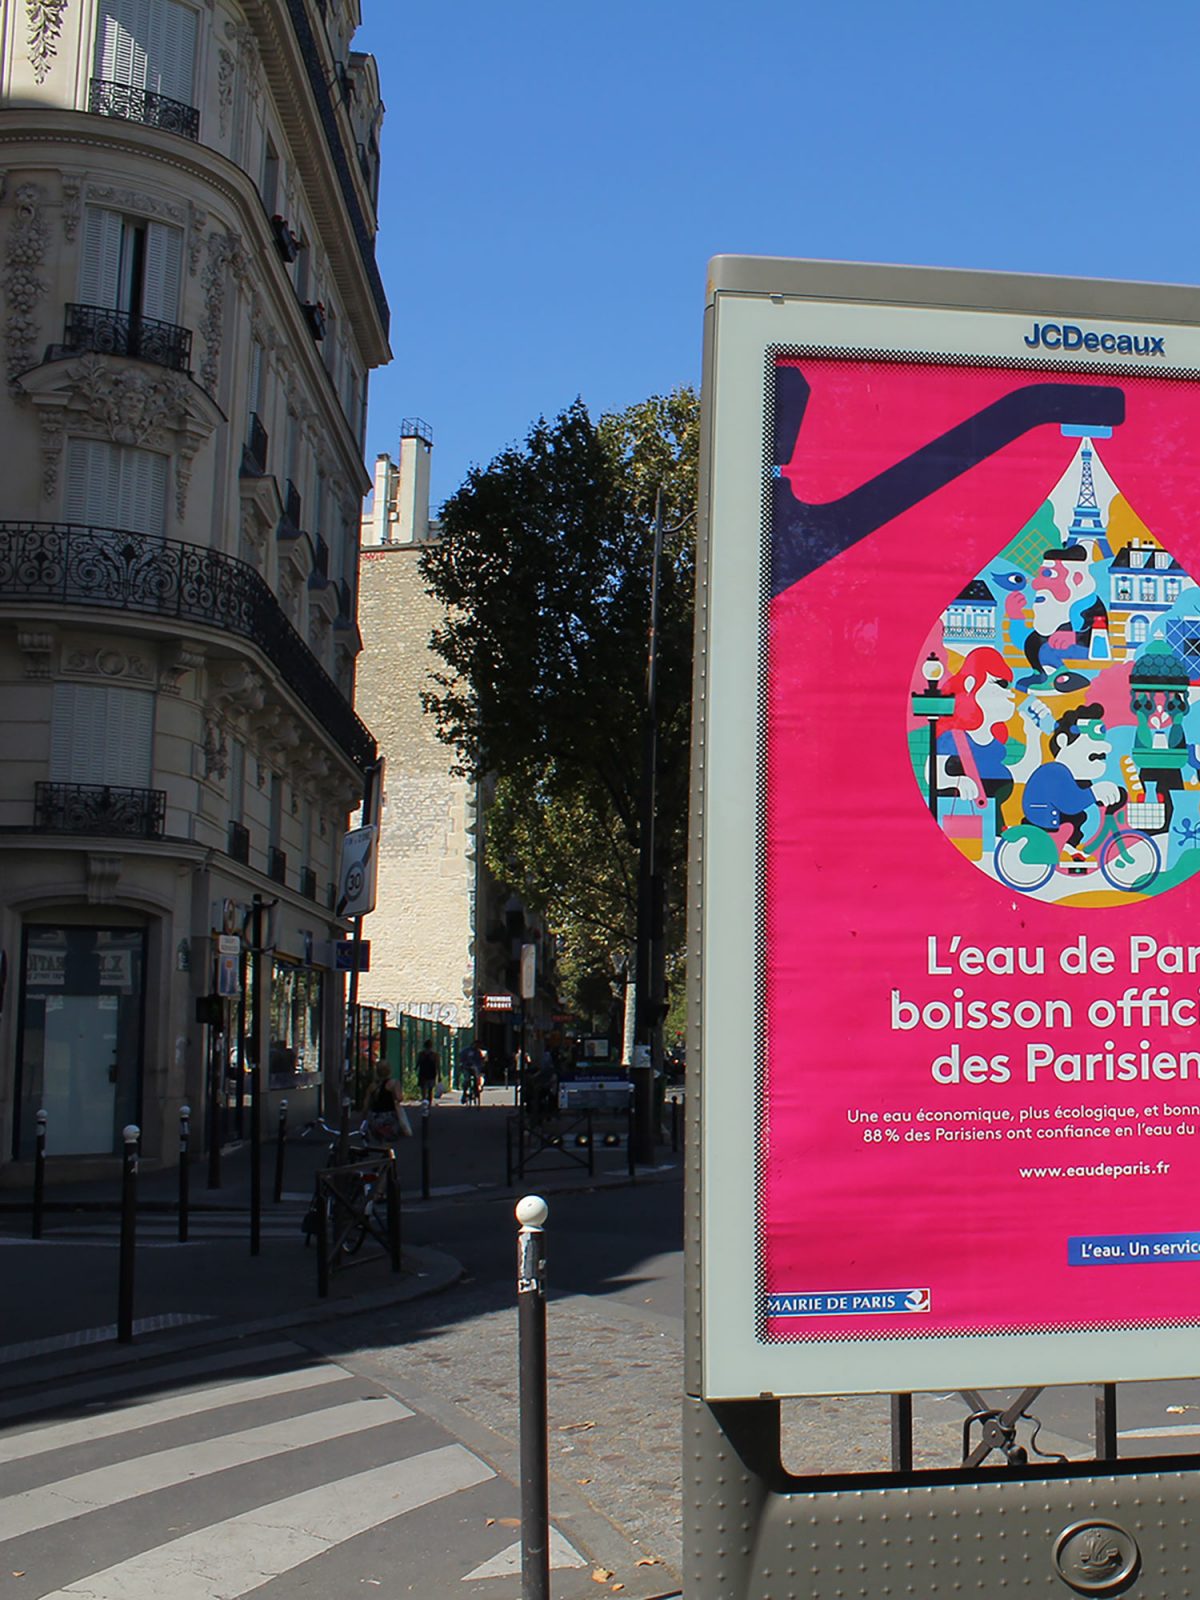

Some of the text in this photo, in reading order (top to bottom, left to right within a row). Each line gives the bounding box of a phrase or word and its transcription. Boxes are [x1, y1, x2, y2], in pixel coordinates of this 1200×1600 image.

[1024, 323, 1166, 356] JCDecaux
[348, 872, 361, 890] 30
[928, 936, 1044, 975] L'eau
[1060, 936, 1115, 974] de
[892, 988, 1071, 1030] boisson
[932, 1044, 1010, 1084] des
[847, 1109, 879, 1124] Une
[882, 1112, 912, 1123] eau
[915, 1107, 1015, 1124] économique,
[1019, 1105, 1051, 1124] plus
[1054, 1104, 1140, 1122] écologique,
[1143, 1104, 1159, 1117] et
[904, 1128, 931, 1142] des
[935, 1126, 1003, 1141] Parisiens
[1006, 1127, 1033, 1140] ont
[1036, 1124, 1111, 1139] confiance
[1114, 1126, 1133, 1137] en
[1137, 1122, 1172, 1137] l'eau
[1175, 1121, 1195, 1136] du
[1020, 1161, 1170, 1179] www.eaudeparis.fr
[1129, 1242, 1151, 1258] Un
[827, 1297, 848, 1310] DE
[852, 1295, 896, 1309] PARIS
